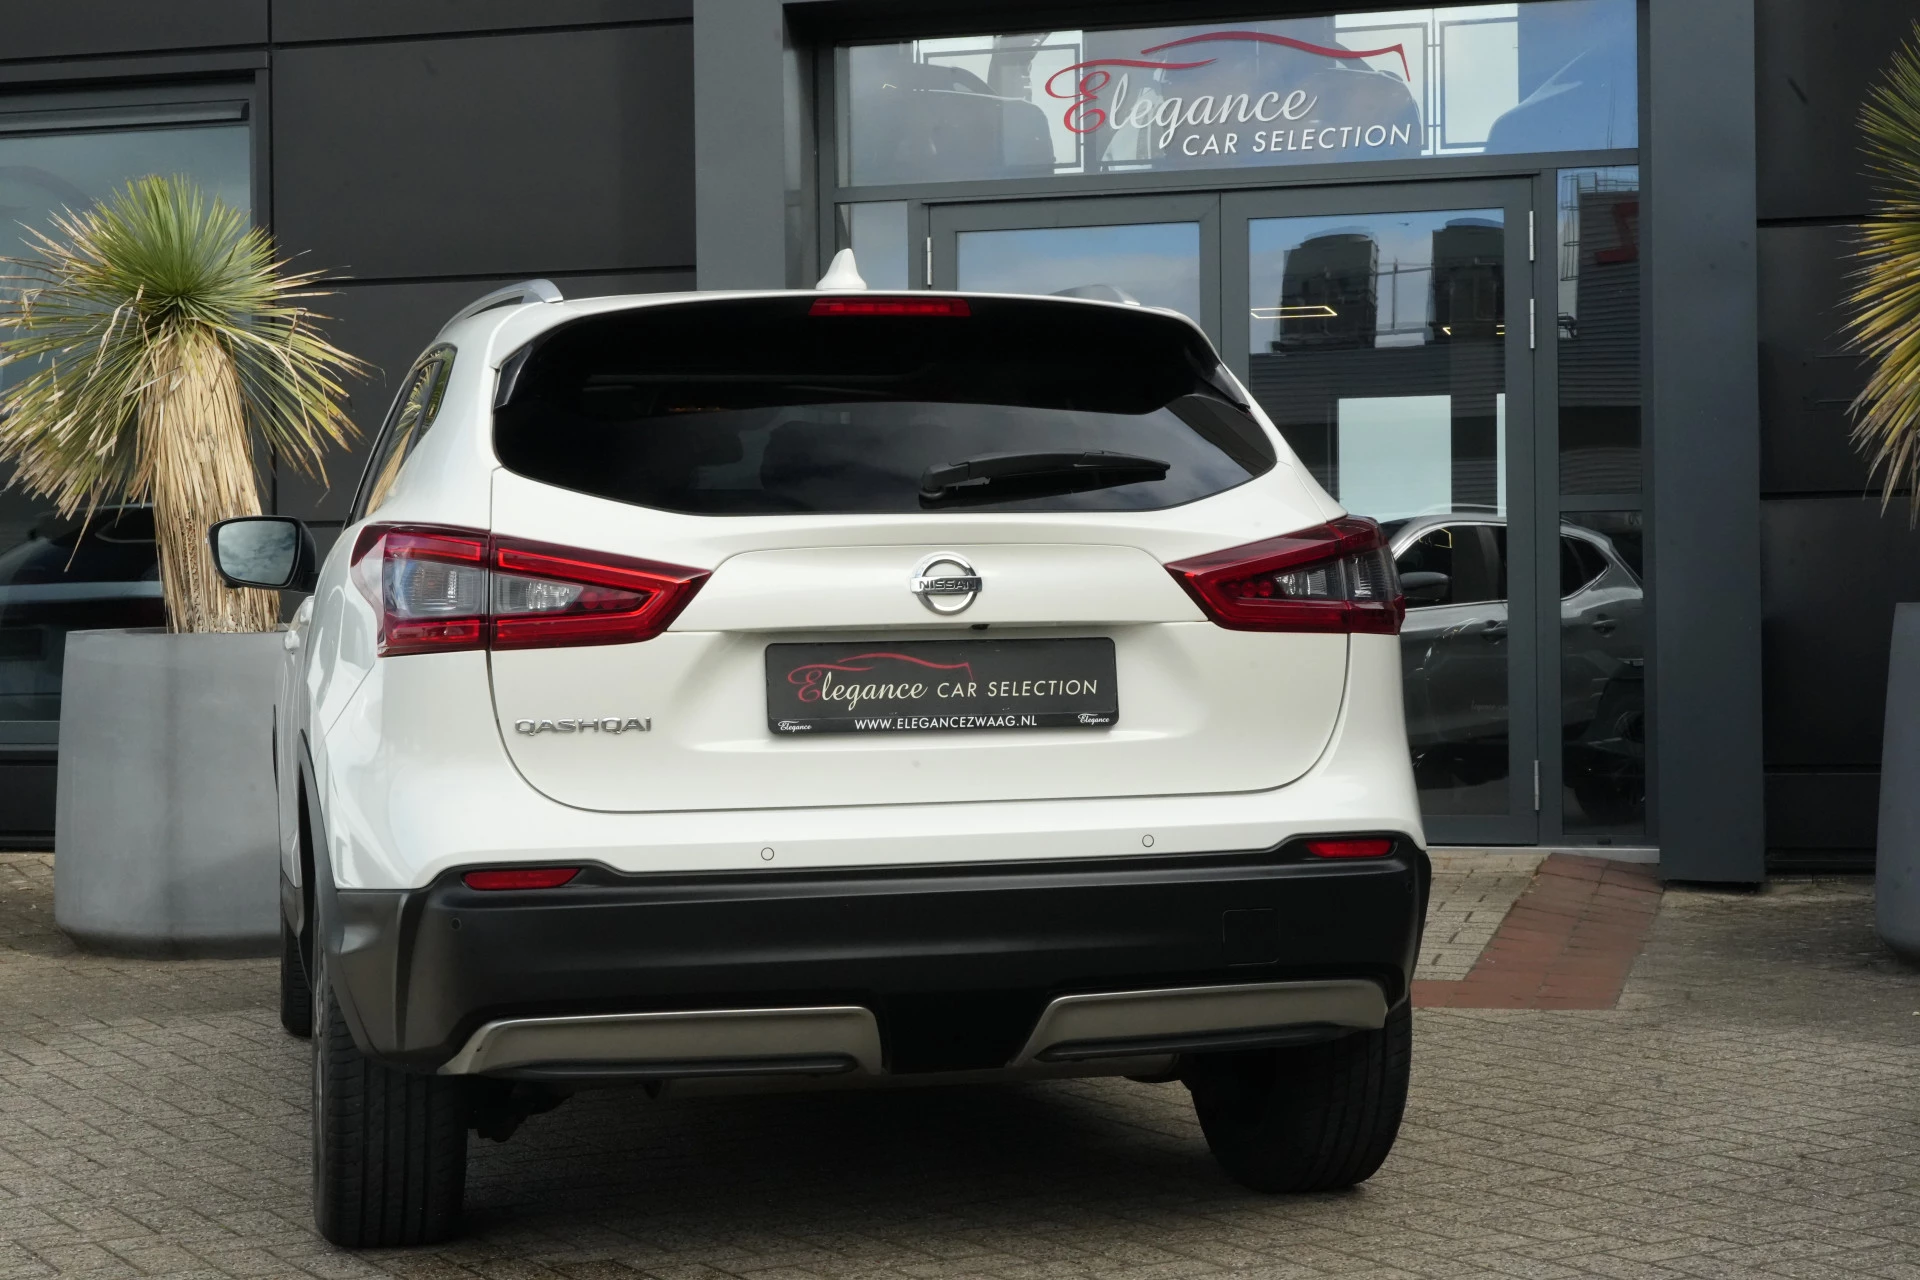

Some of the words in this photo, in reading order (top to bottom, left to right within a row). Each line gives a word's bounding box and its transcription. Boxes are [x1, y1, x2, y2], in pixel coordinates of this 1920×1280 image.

[1045, 58, 1317, 150] Elegance
[1182, 134, 1238, 157] CAR
[1252, 123, 1412, 153] SELECTION
[919, 579, 977, 591] NISSAN
[787, 664, 929, 711] Elegance
[937, 682, 978, 698] CAR
[987, 679, 1098, 697] SELECTION
[514, 716, 653, 737] QASHQAI
[777, 720, 812, 732] Elegance
[854, 714, 1038, 731] WWW.ELEGANCEZWAAG.NL
[1077, 713, 1110, 725] Elegance
